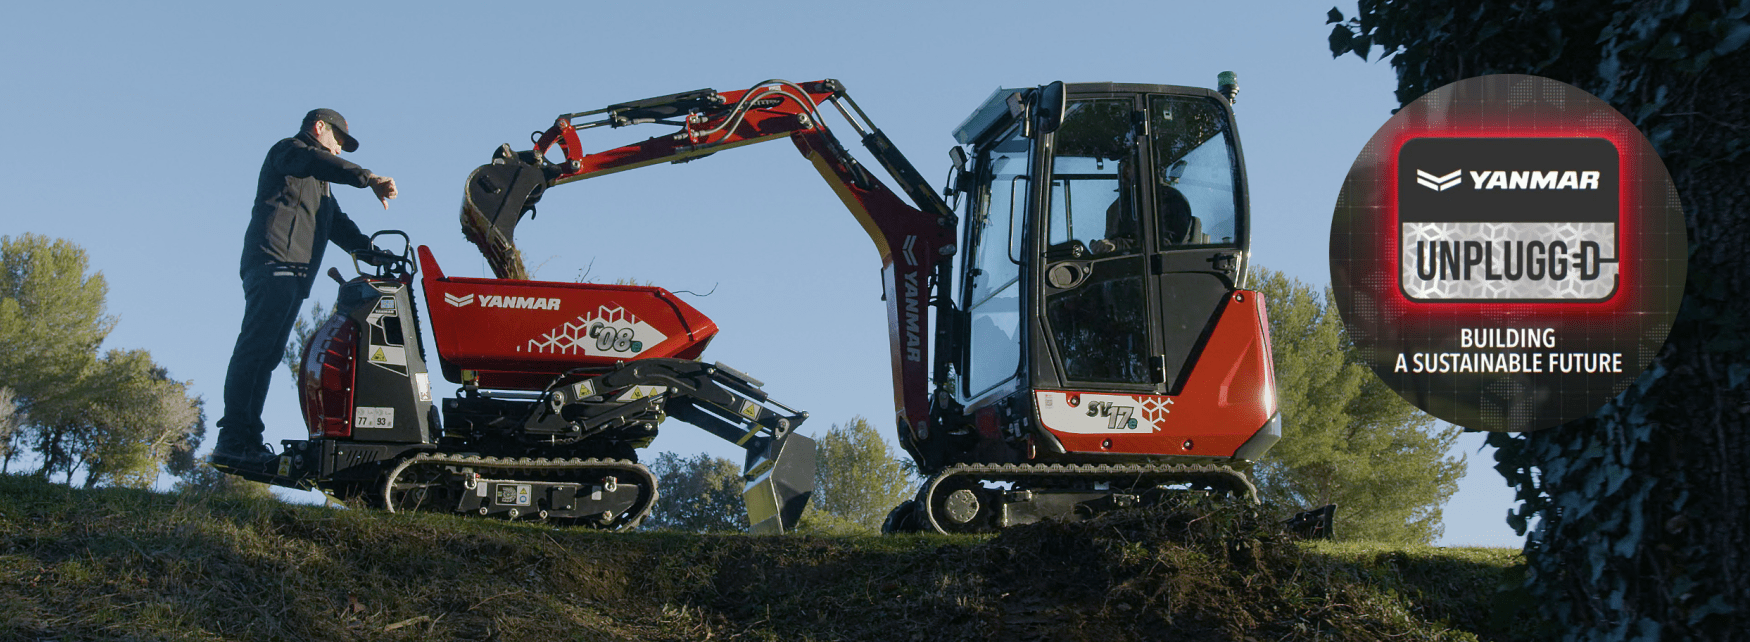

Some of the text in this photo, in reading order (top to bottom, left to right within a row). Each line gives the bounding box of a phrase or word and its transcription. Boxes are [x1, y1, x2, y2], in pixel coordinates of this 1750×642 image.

[478, 294, 561, 311] YANMAR
[904, 271, 921, 363] YANMAR
[358, 416, 367, 425] 77
[377, 417, 386, 426] 93
